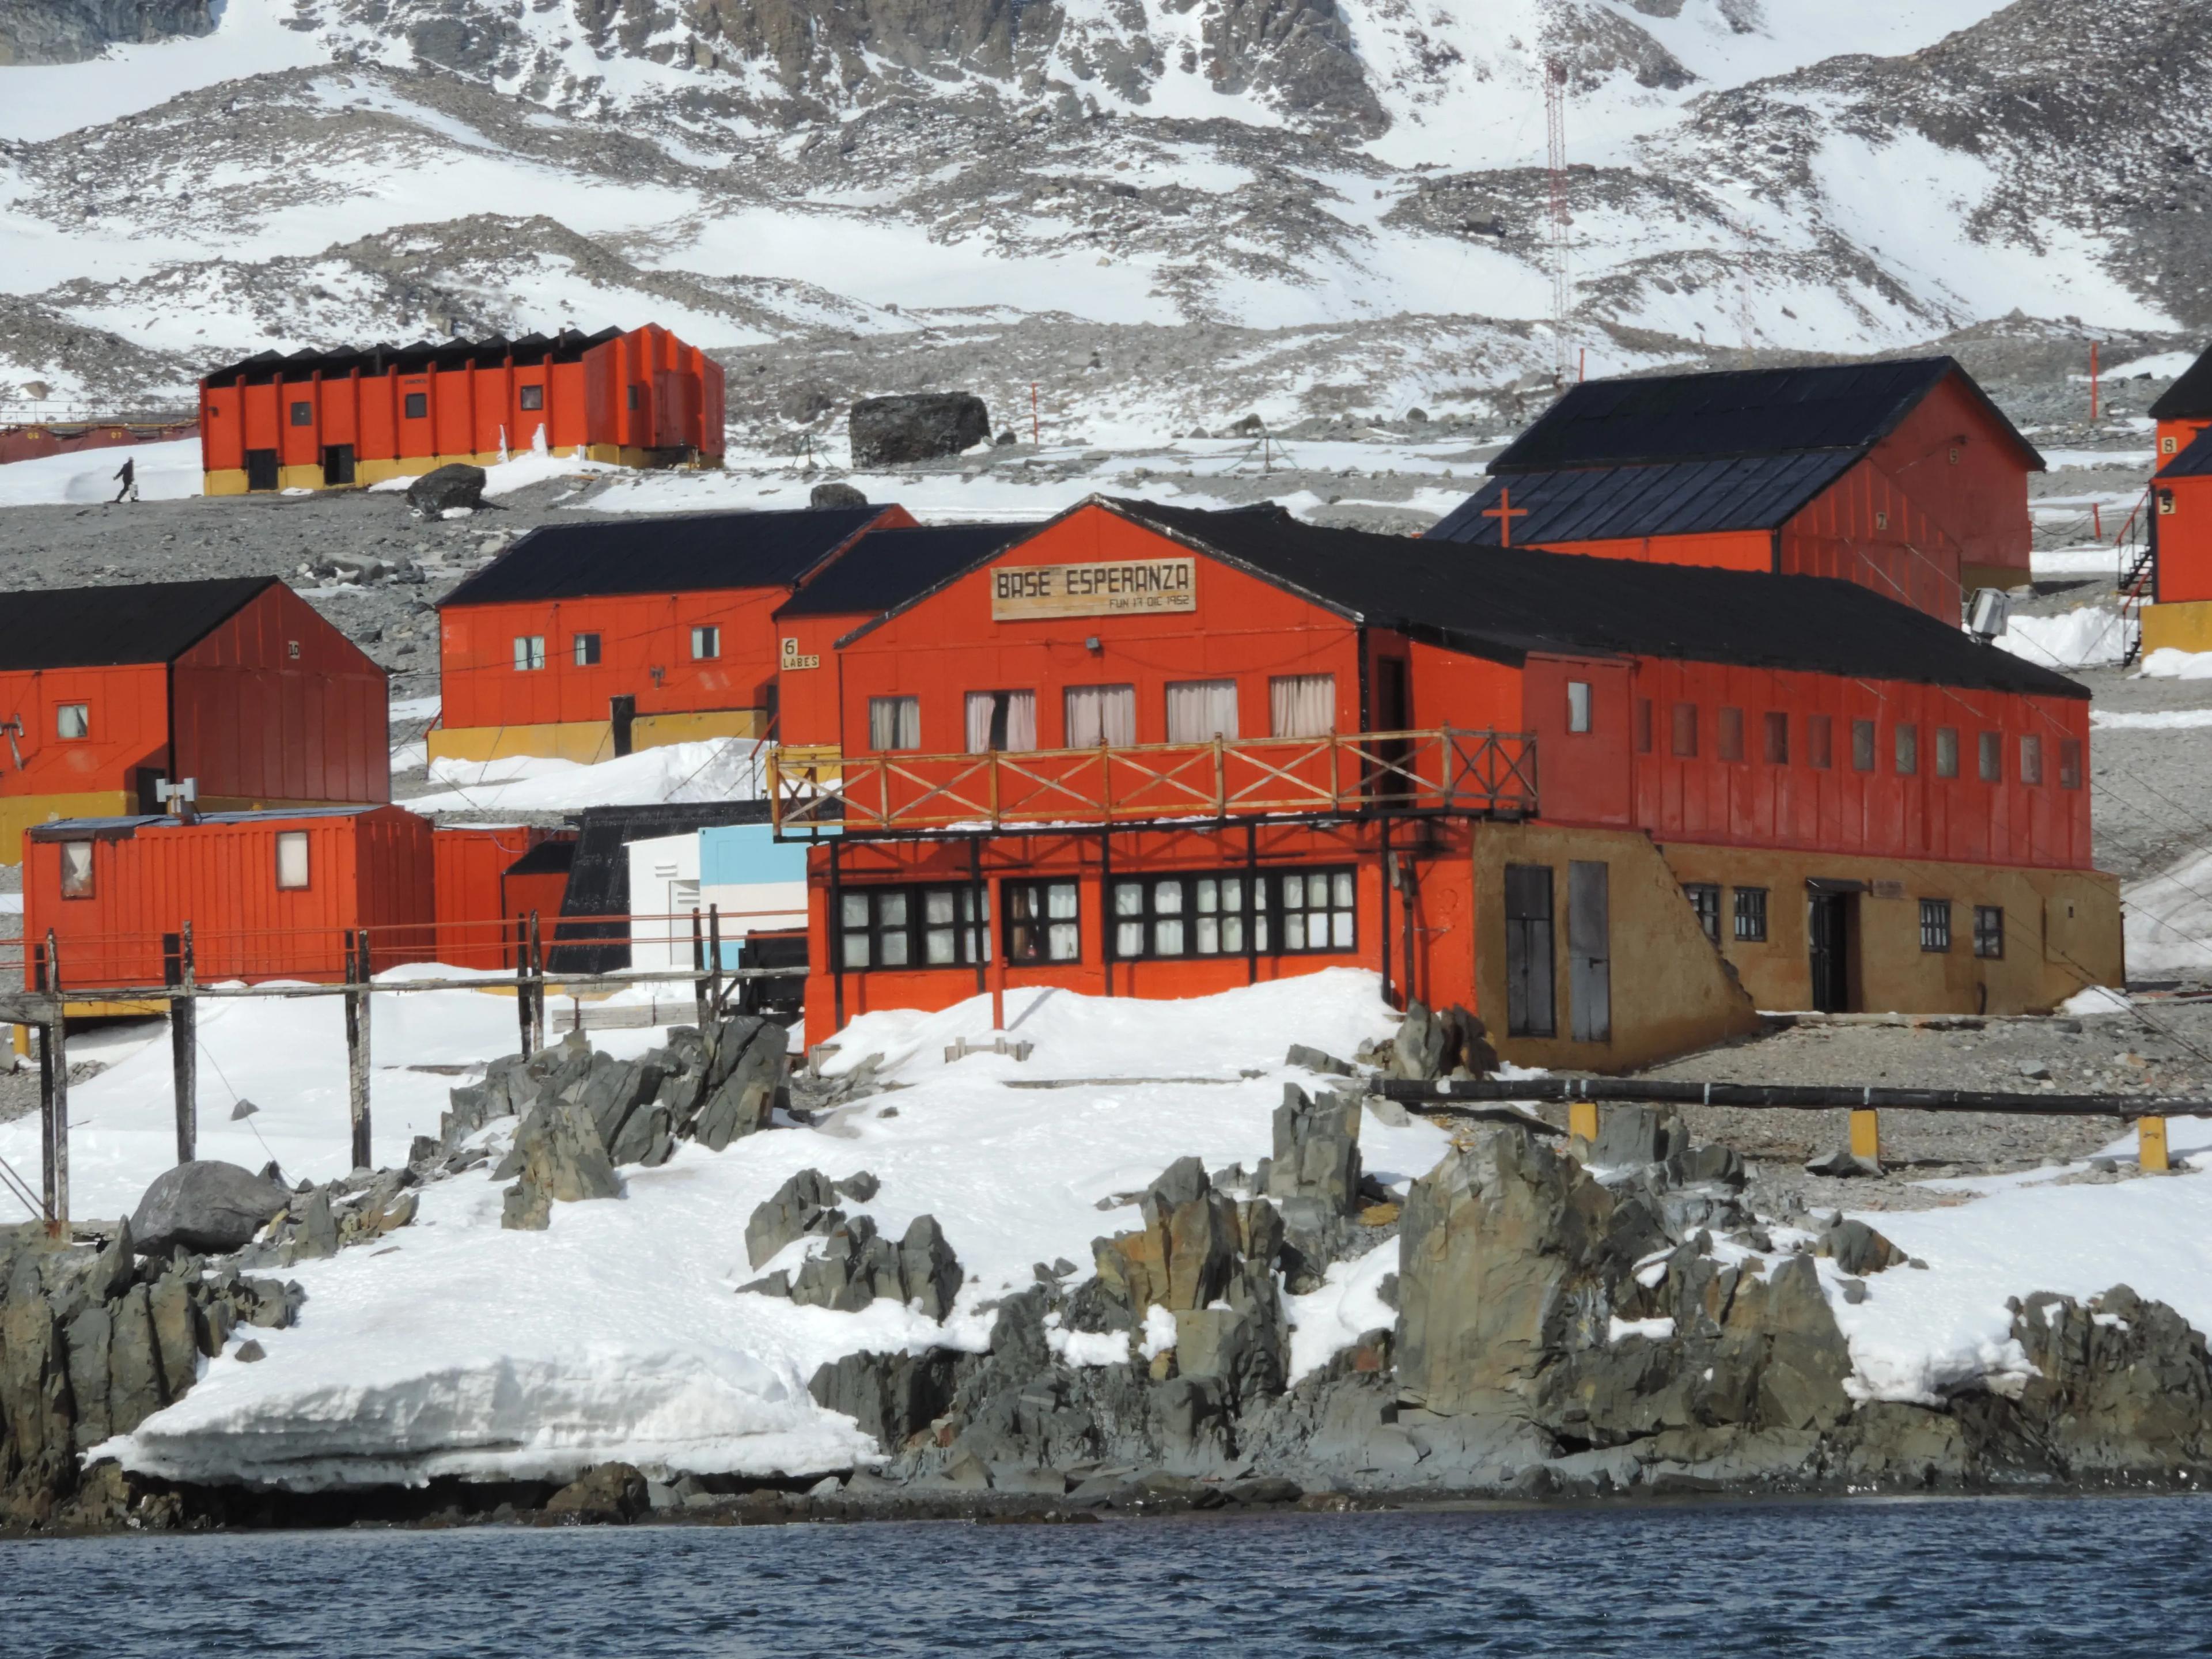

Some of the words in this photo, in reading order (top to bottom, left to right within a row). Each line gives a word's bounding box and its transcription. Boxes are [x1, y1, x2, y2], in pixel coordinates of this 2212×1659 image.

[2165, 439, 2173, 452] 8
[2162, 497, 2172, 513] 5
[1878, 513, 1885, 528] 7
[997, 571, 1051, 599] BASE
[1066, 564, 1188, 594] ESPERANZA
[1109, 599, 1129, 608] FUN
[1133, 597, 1143, 608] 17
[1167, 594, 1190, 605] 1952
[289, 643, 300, 656] 10
[785, 639, 794, 655] 6
[783, 656, 817, 668] LABES
